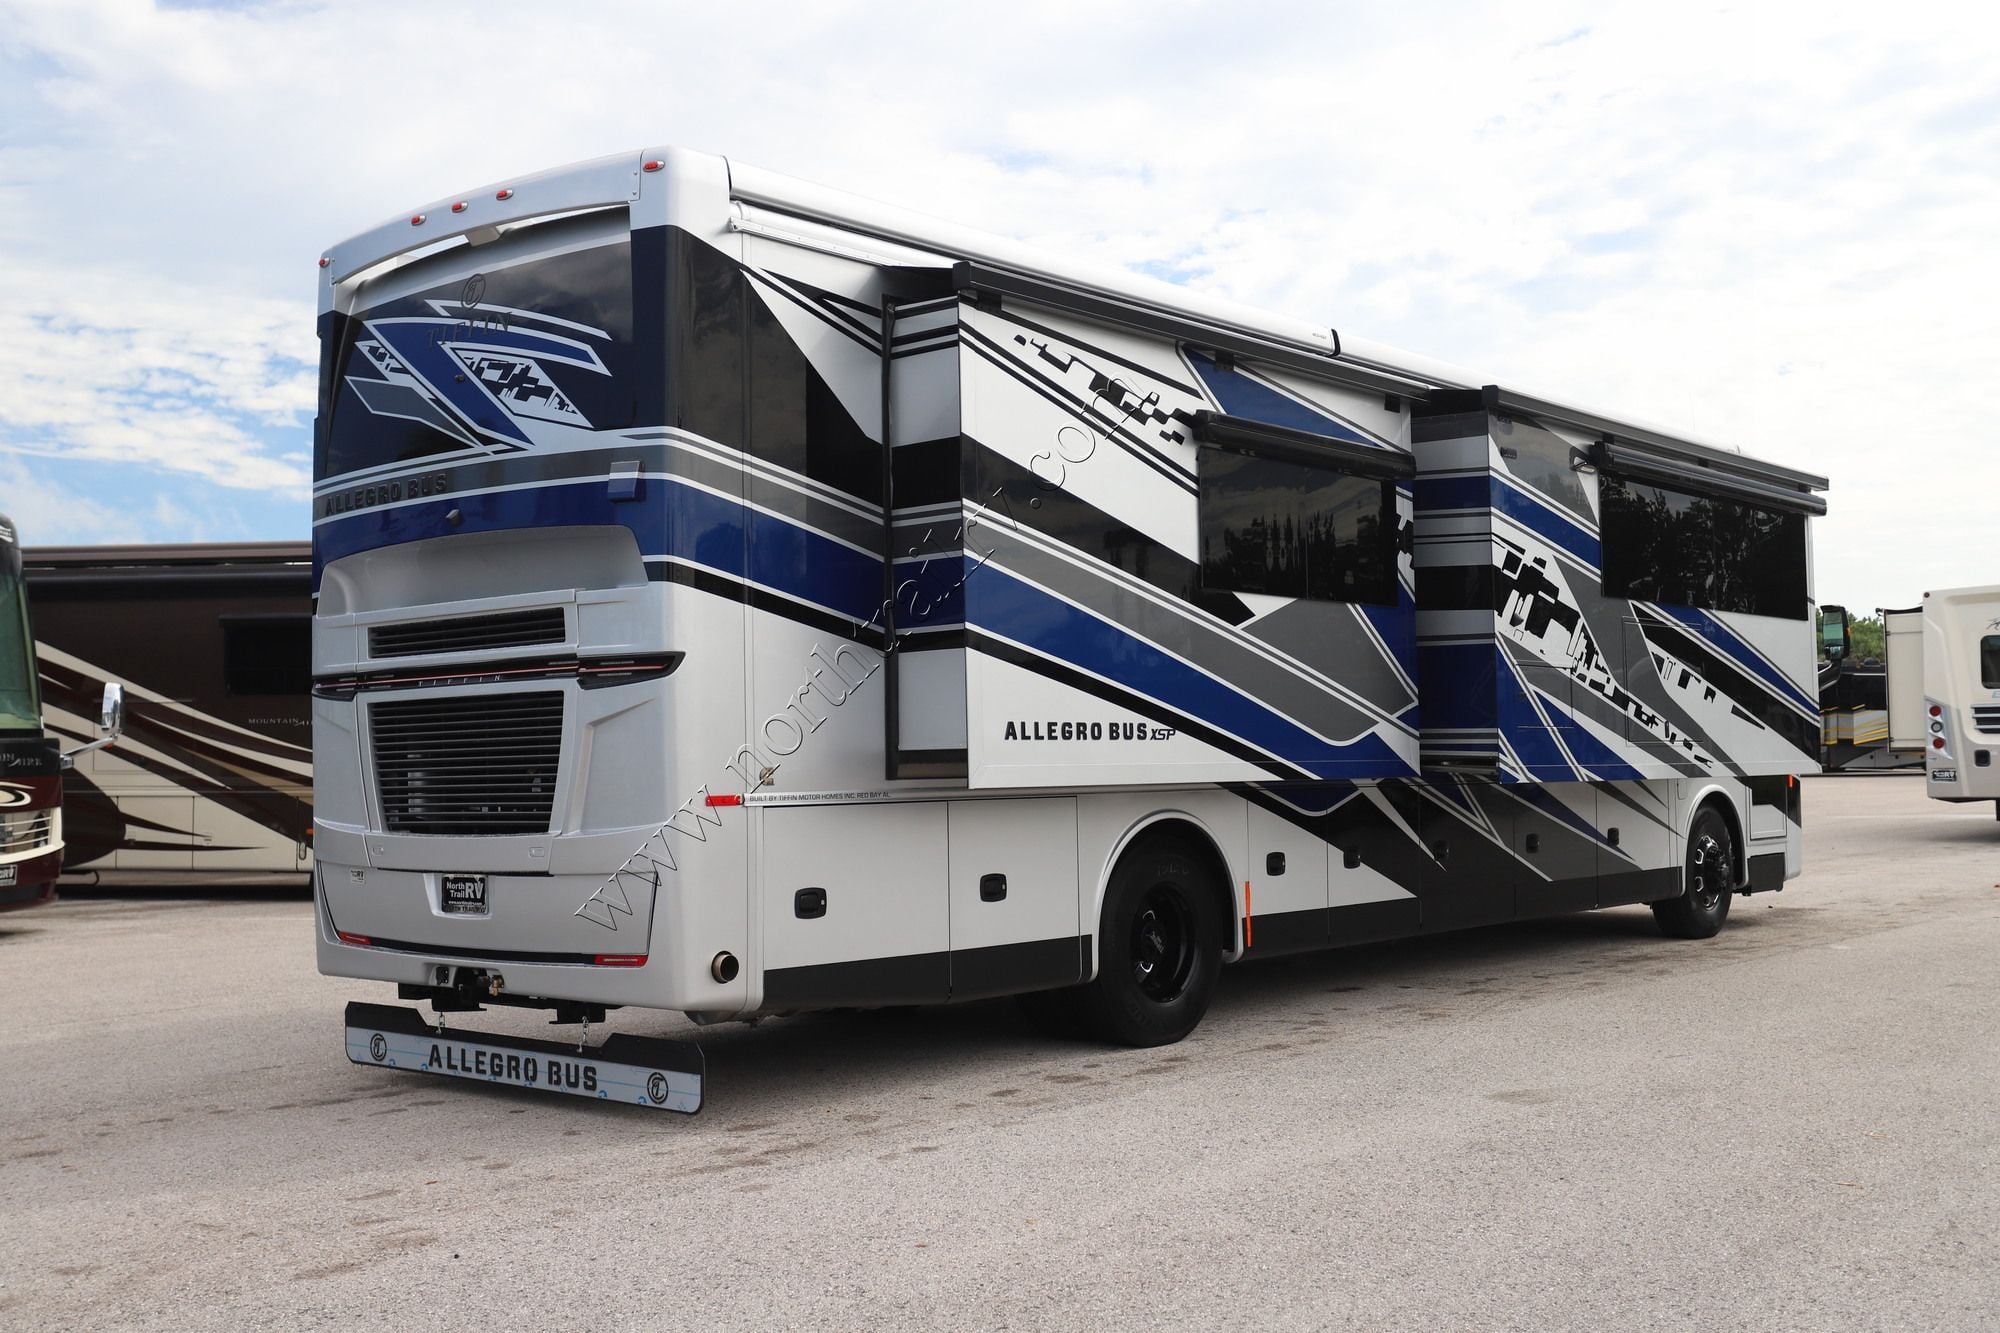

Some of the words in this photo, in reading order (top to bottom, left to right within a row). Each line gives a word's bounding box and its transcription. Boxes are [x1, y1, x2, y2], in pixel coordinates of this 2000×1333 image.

[325, 482, 402, 516] ALLEGRO
[407, 473, 447, 498] BUS
[418, 675, 500, 687] TIFFIN
[1004, 721, 1102, 741] ALLEGRO
[1108, 722, 1148, 741] BUS
[1150, 728, 1176, 741] XSP
[446, 881, 465, 890] North
[465, 881, 484, 899] RV
[450, 890, 465, 899] Trail
[428, 1044, 538, 1083] ALLEGRO
[547, 1060, 598, 1092] BUS
